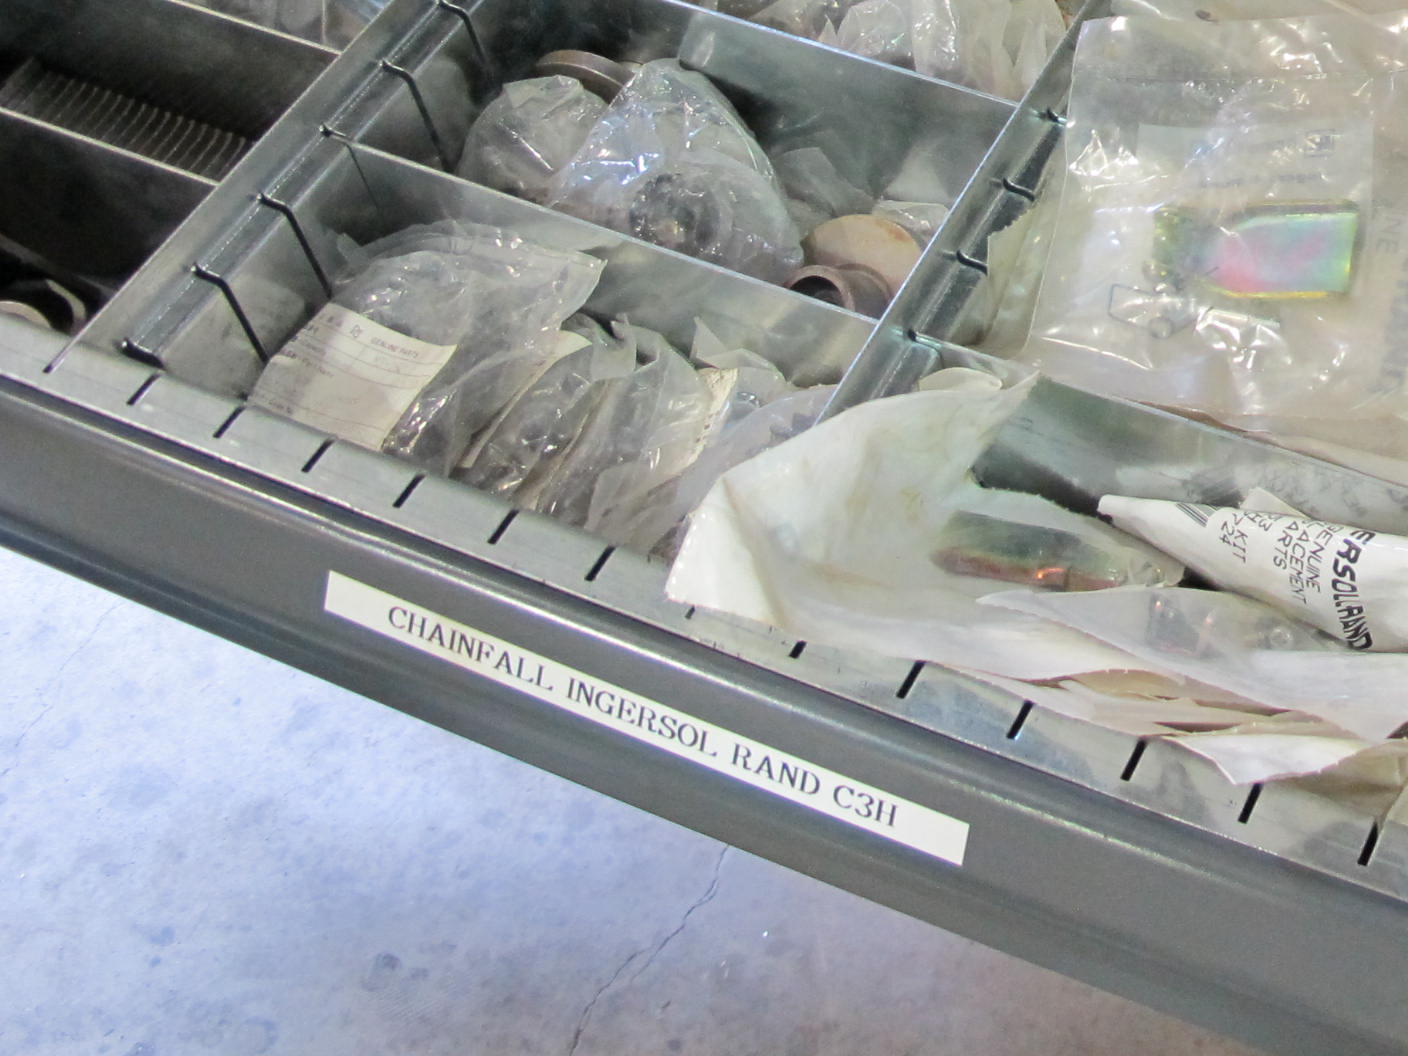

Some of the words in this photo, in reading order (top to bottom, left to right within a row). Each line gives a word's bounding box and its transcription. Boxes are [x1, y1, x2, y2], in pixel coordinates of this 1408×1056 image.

[1232, 529, 1249, 564] KIT
[387, 605, 554, 691] CHAINFALL
[567, 676, 718, 758] INGERSOL
[731, 742, 821, 796] RAND
[832, 784, 899, 828] C3H
